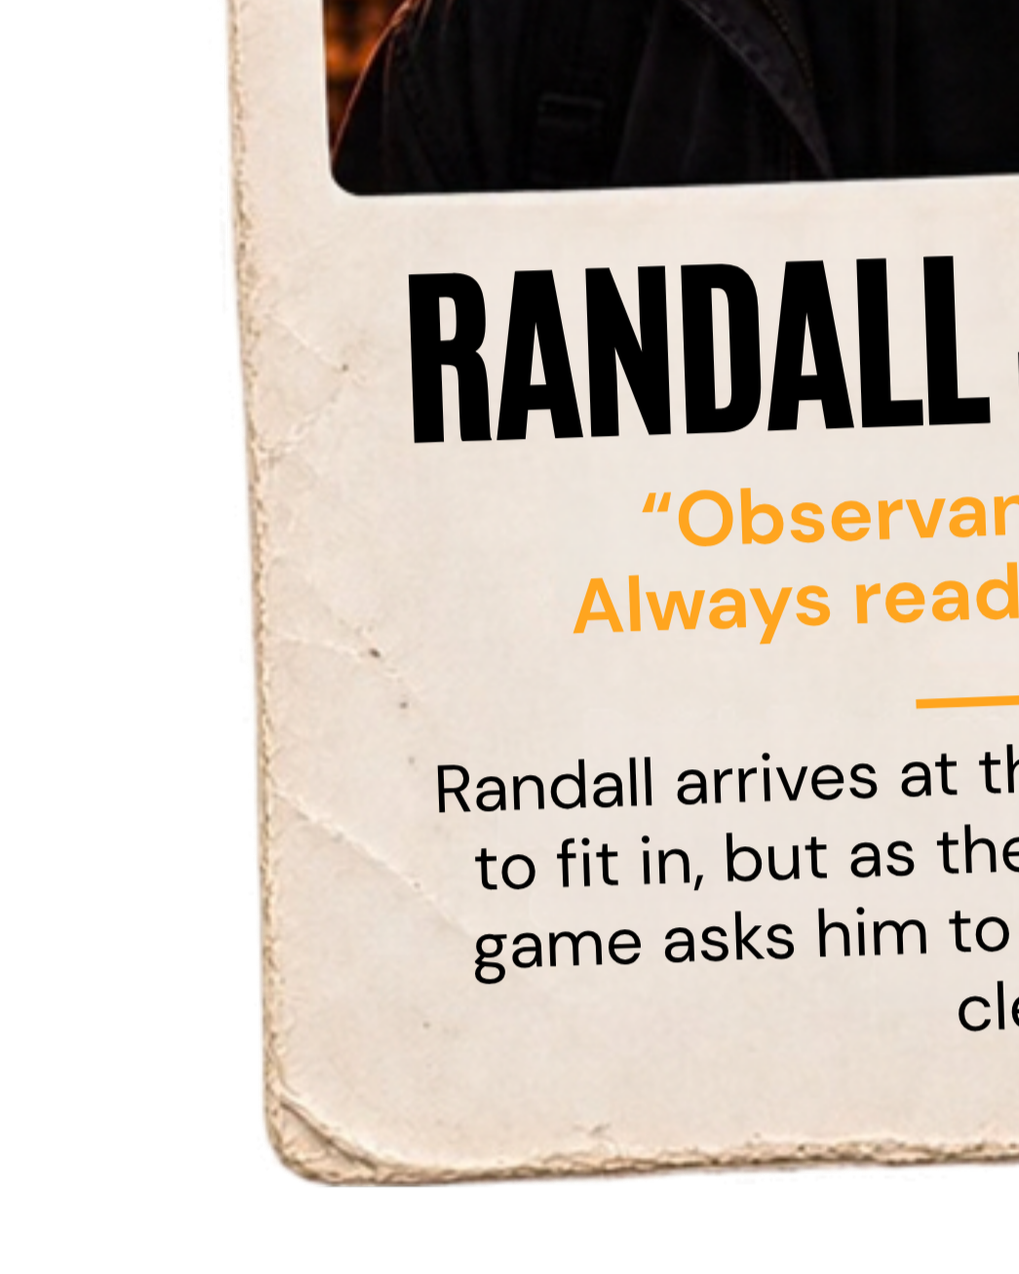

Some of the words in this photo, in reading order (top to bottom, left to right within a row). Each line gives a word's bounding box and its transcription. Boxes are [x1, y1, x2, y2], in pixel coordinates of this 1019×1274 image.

[408, 255, 991, 444] RANDALL
[572, 574, 831, 645] Always
[437, 756, 653, 813] Randall
[677, 752, 878, 806] arrives
[901, 753, 958, 798] at
[474, 847, 536, 891] to
[556, 837, 619, 888] fit
[641, 835, 704, 891] in,
[725, 832, 828, 882] but
[850, 840, 915, 879] as
[474, 928, 642, 985] game
[664, 910, 795, 963] asks
[817, 906, 927, 958] him
[948, 910, 1010, 953] to
